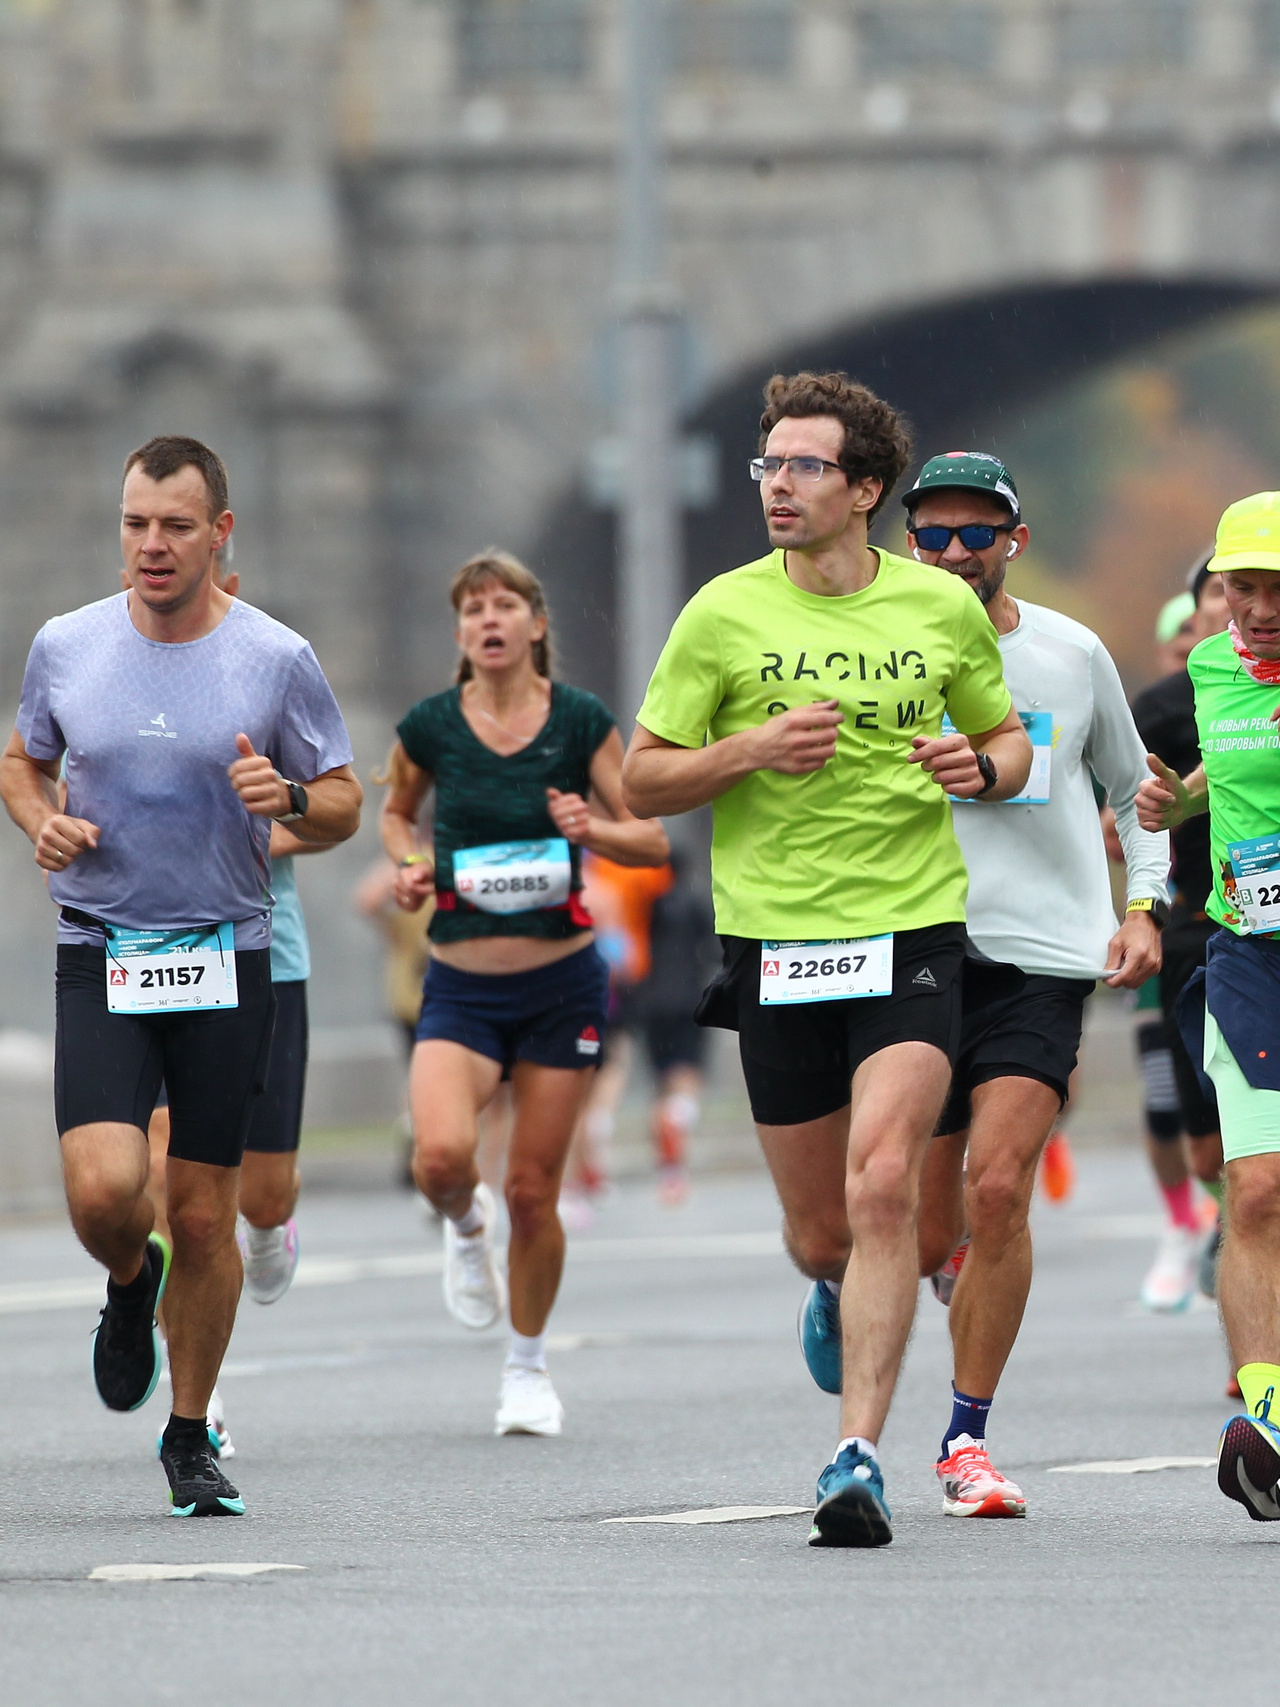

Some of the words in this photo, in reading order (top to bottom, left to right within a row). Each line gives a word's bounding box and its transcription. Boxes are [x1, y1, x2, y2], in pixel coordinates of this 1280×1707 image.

[760, 650, 927, 682] RACING
[767, 700, 925, 730] EW
[1209, 720, 1217, 733] К
[1216, 718, 1250, 733] НОВЫМ
[1249, 717, 1280, 732] РЕКОР
[1215, 737, 1266, 753] ЗДОРОВЫМ
[481, 875, 550, 894] 20885
[112, 971, 124, 982] A
[140, 966, 205, 988] 21157
[764, 962, 778, 975] A
[788, 955, 868, 980] 22667
